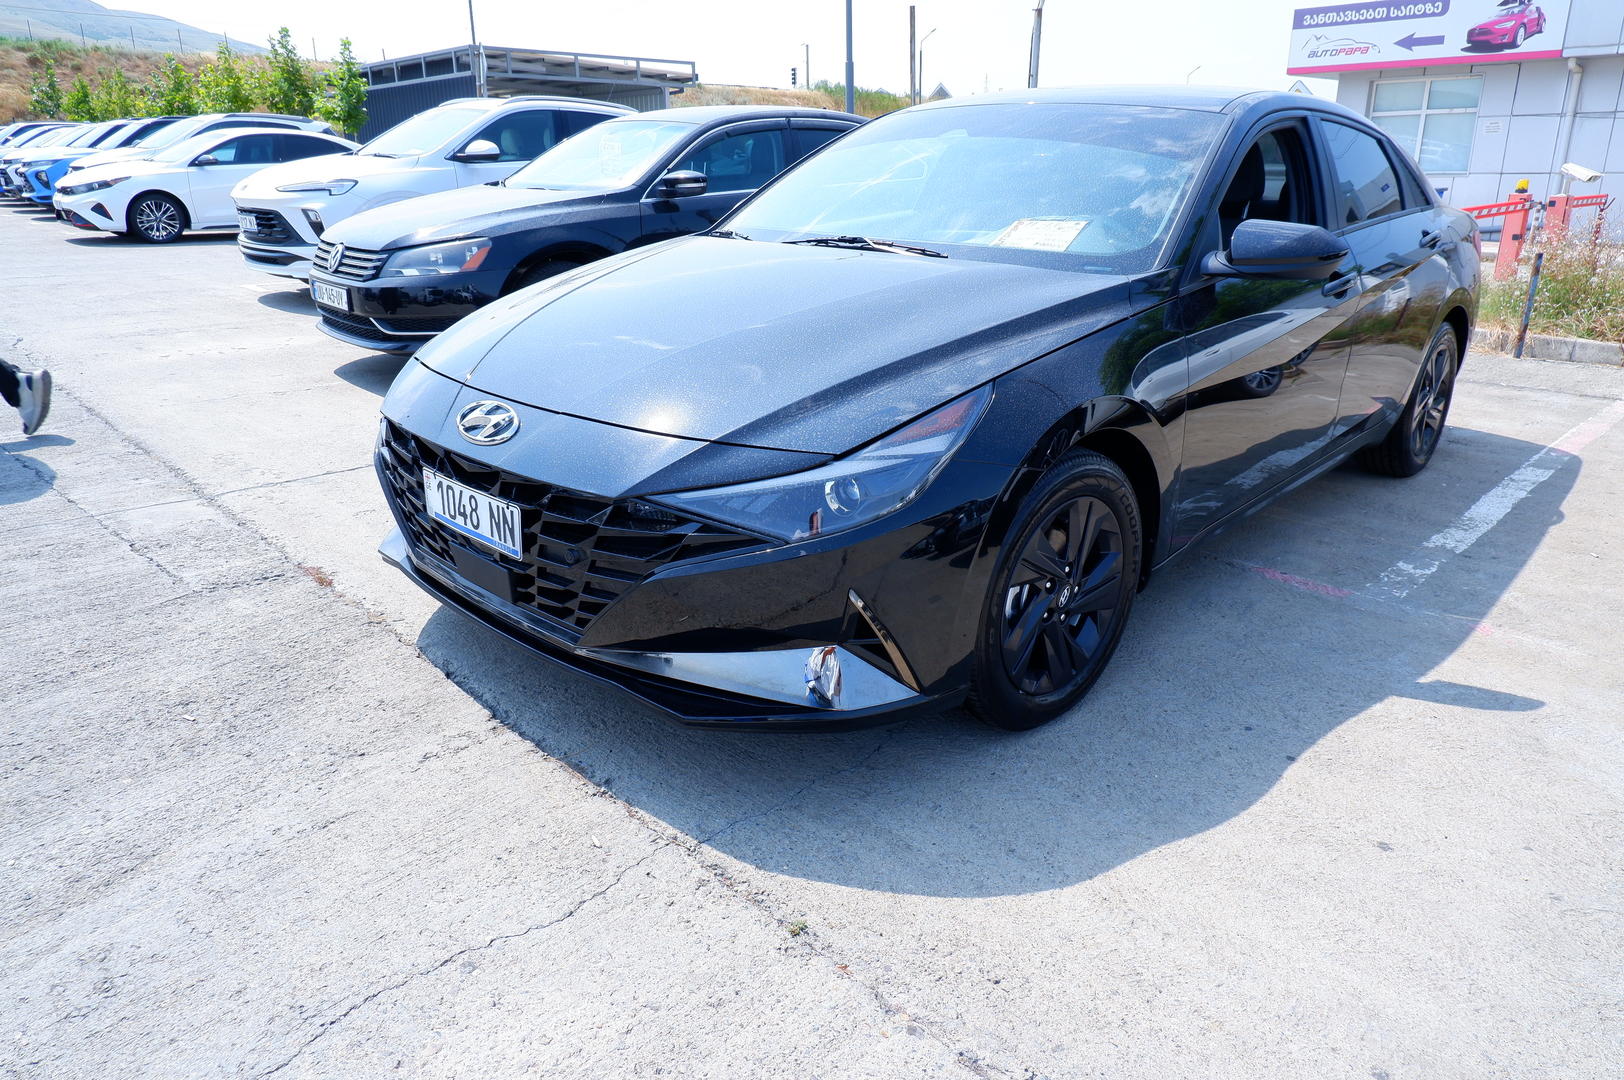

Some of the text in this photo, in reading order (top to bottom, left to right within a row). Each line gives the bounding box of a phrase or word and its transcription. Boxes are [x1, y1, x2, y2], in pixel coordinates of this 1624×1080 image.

[1390, 2, 1443, 17] საიტზე
[437, 481, 515, 547] 1048 NN
